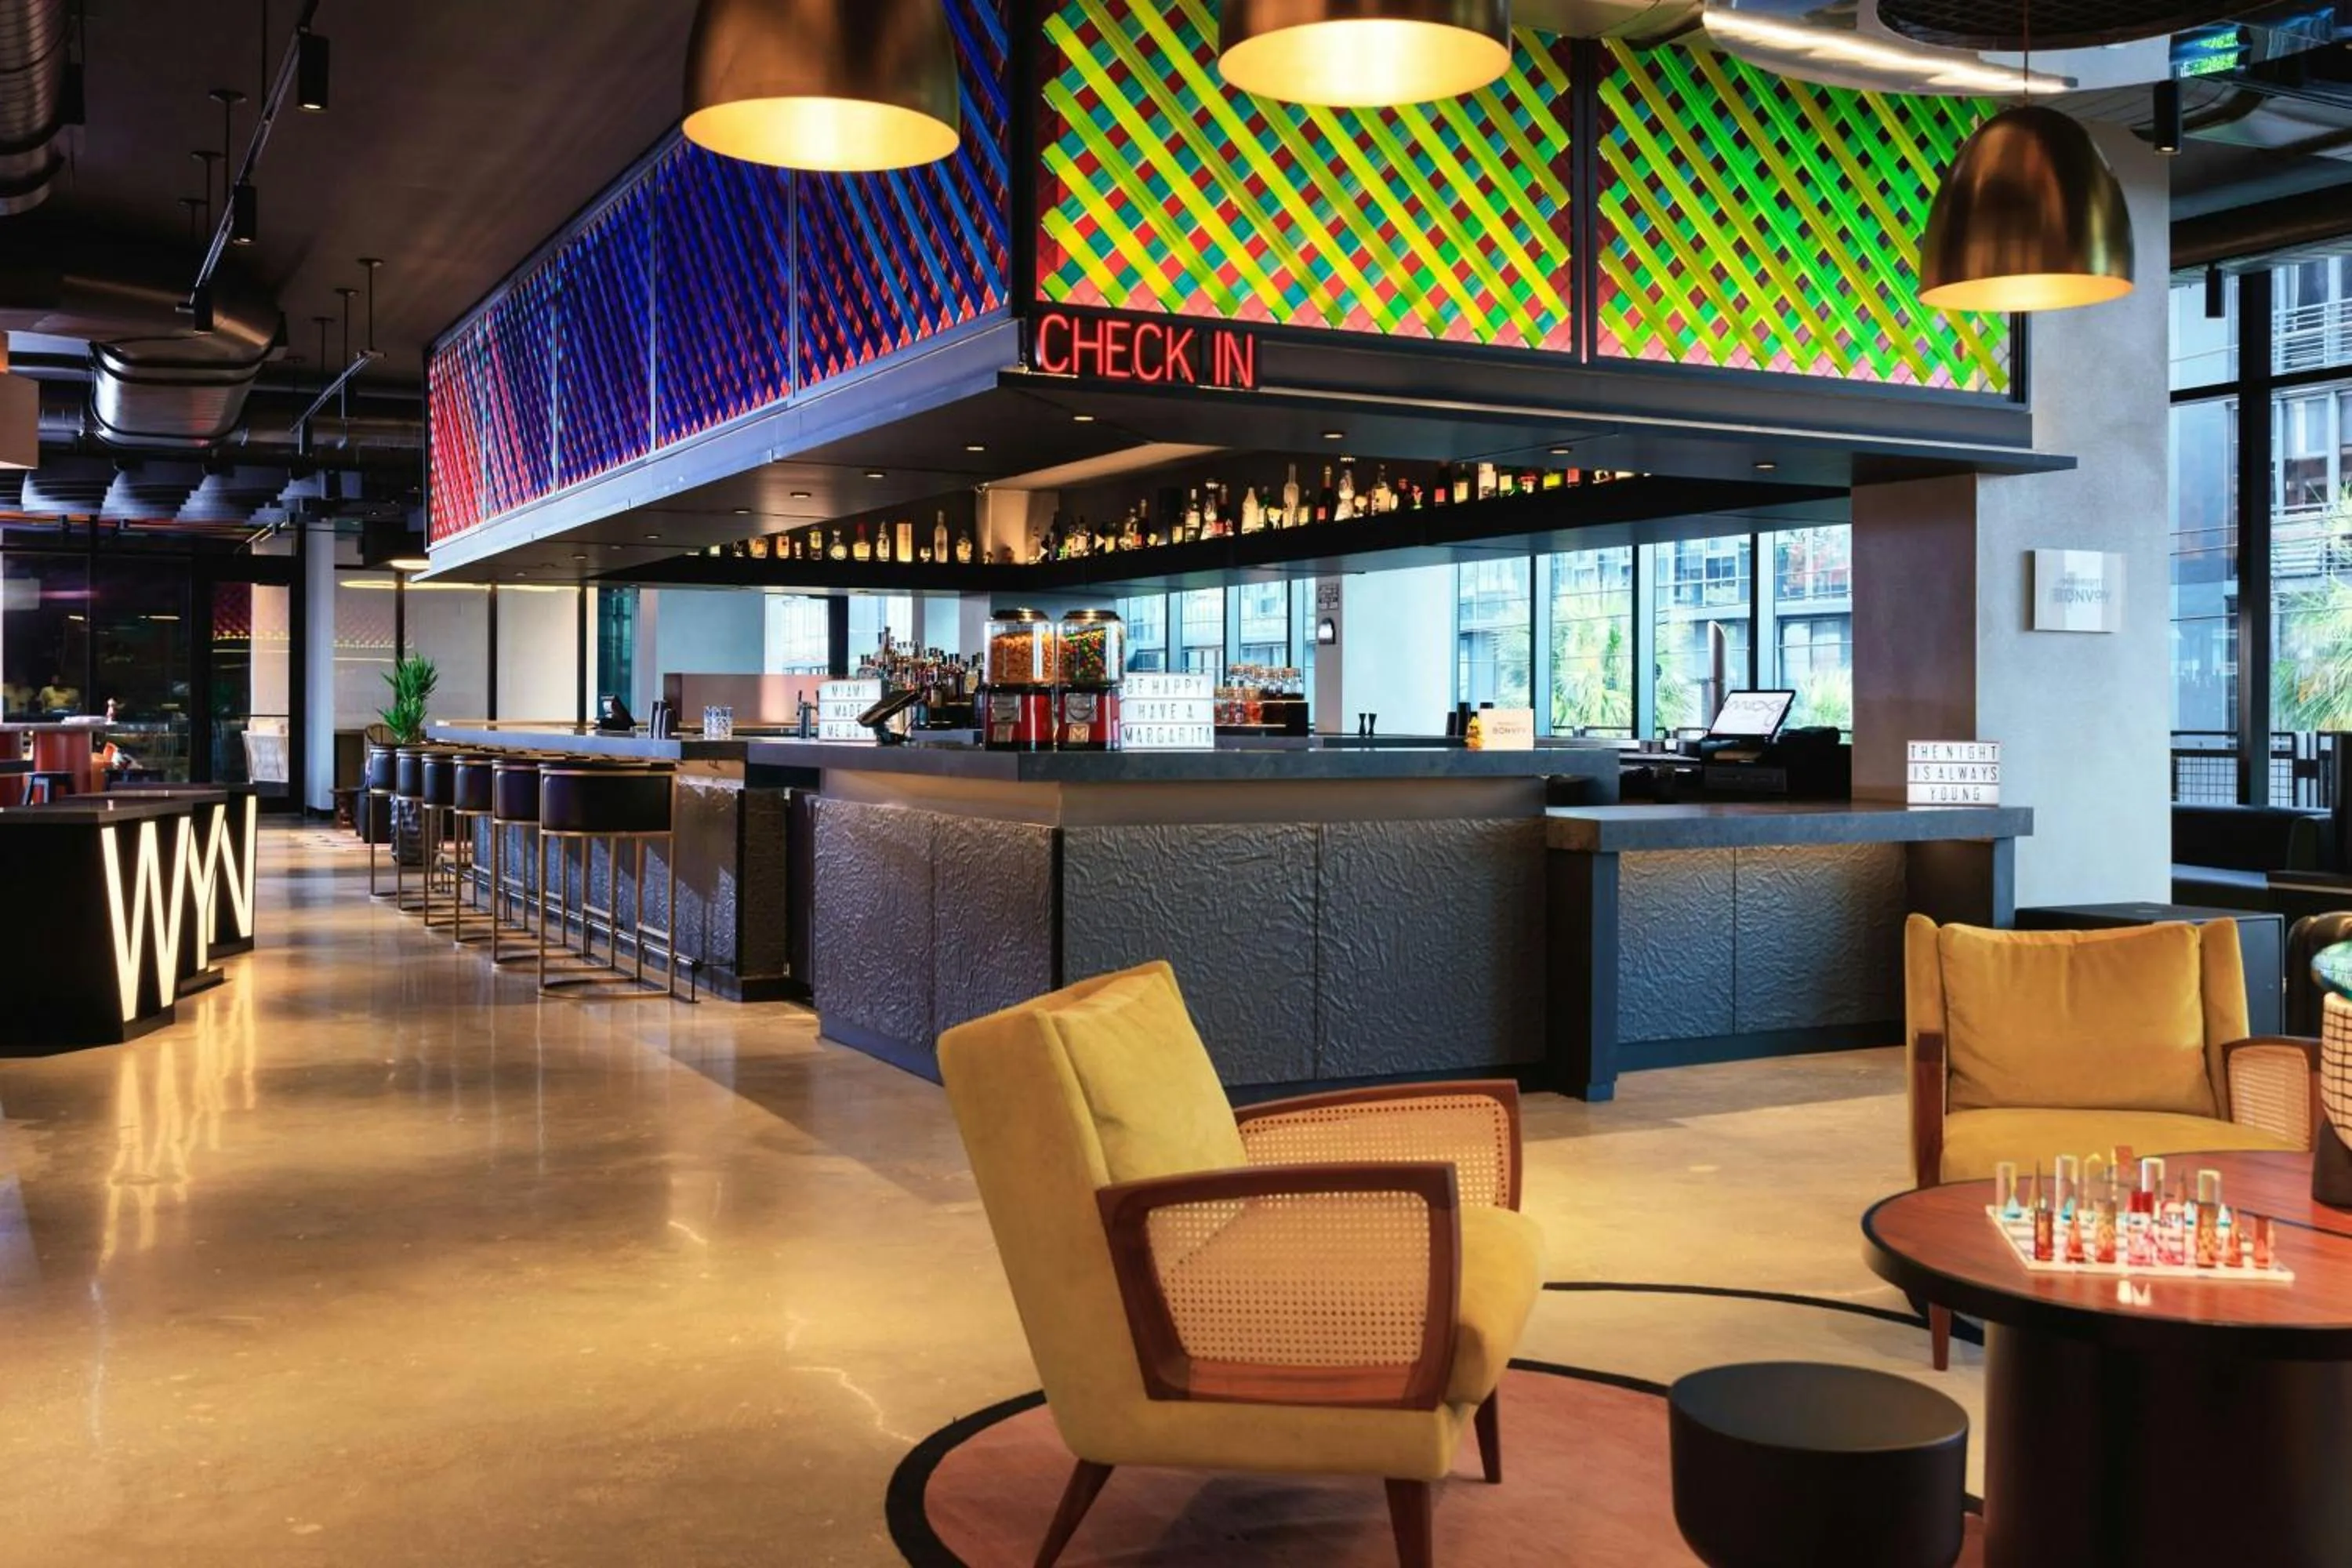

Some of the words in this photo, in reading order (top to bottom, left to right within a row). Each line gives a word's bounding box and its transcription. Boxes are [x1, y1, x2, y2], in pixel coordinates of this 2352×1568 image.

[1038, 314, 1195, 383] CHECK
[1215, 328, 1254, 389] IN
[832, 684, 865, 696] MIAMI
[1127, 677, 1145, 695] BE
[1152, 677, 1203, 695] HAPPY
[835, 704, 862, 717] MADE
[1138, 702, 1178, 720] HAVE
[1186, 702, 1195, 720] A
[1124, 727, 1212, 745] MARGARITA
[1911, 744, 1937, 760] THE
[1947, 744, 1996, 760] NIGHT
[1914, 765, 1930, 780] IS
[1938, 765, 1998, 782] ALWAYS
[1929, 786, 1980, 801] YOUNG
